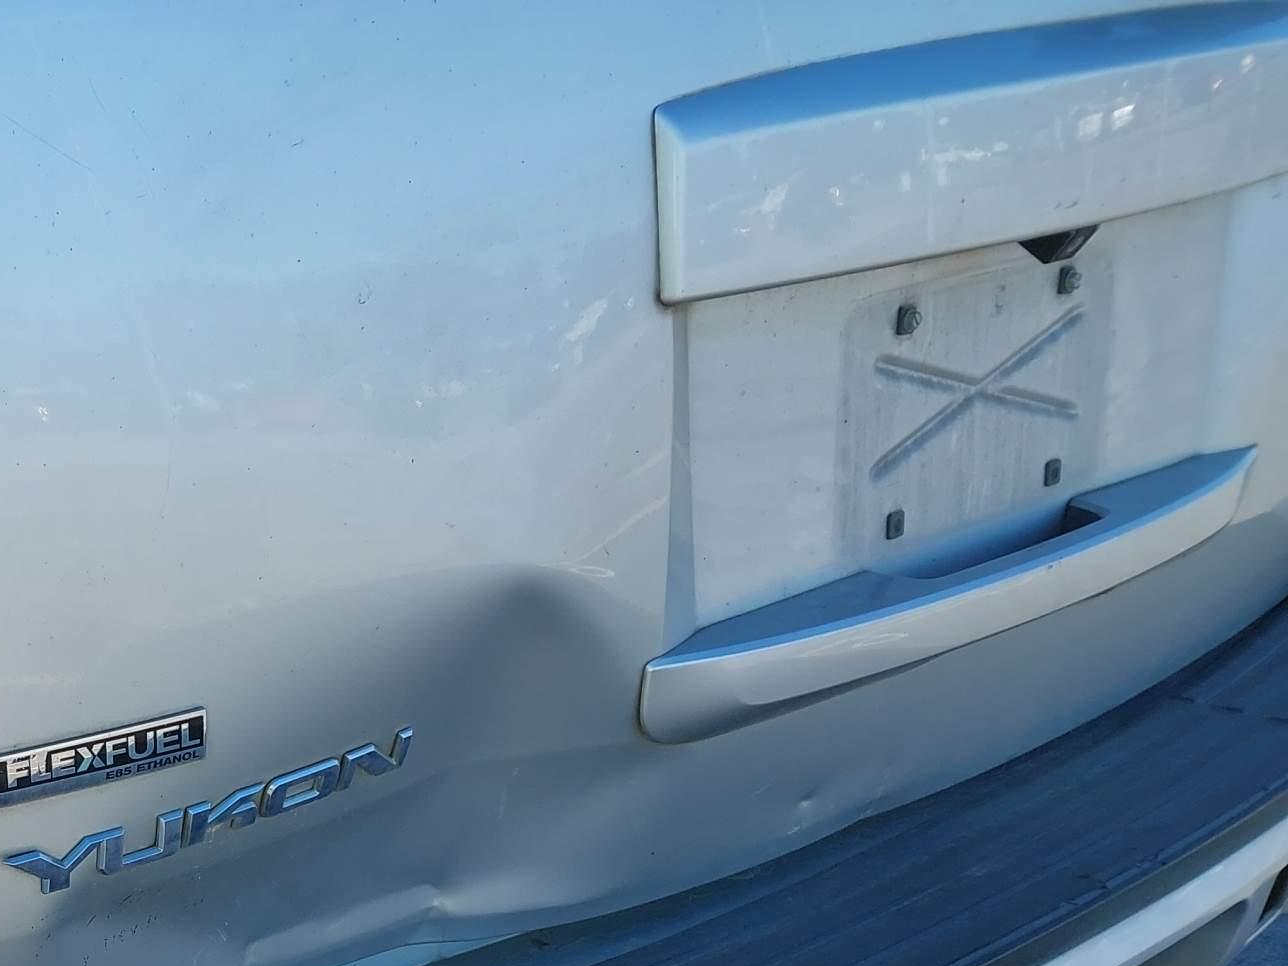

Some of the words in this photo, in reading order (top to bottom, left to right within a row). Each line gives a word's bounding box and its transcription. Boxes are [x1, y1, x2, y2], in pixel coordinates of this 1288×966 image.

[6, 722, 202, 789] FLEXFUEL
[105, 766, 132, 780] E85
[136, 750, 200, 773] ETHANOL
[3, 726, 414, 894] YUKON
